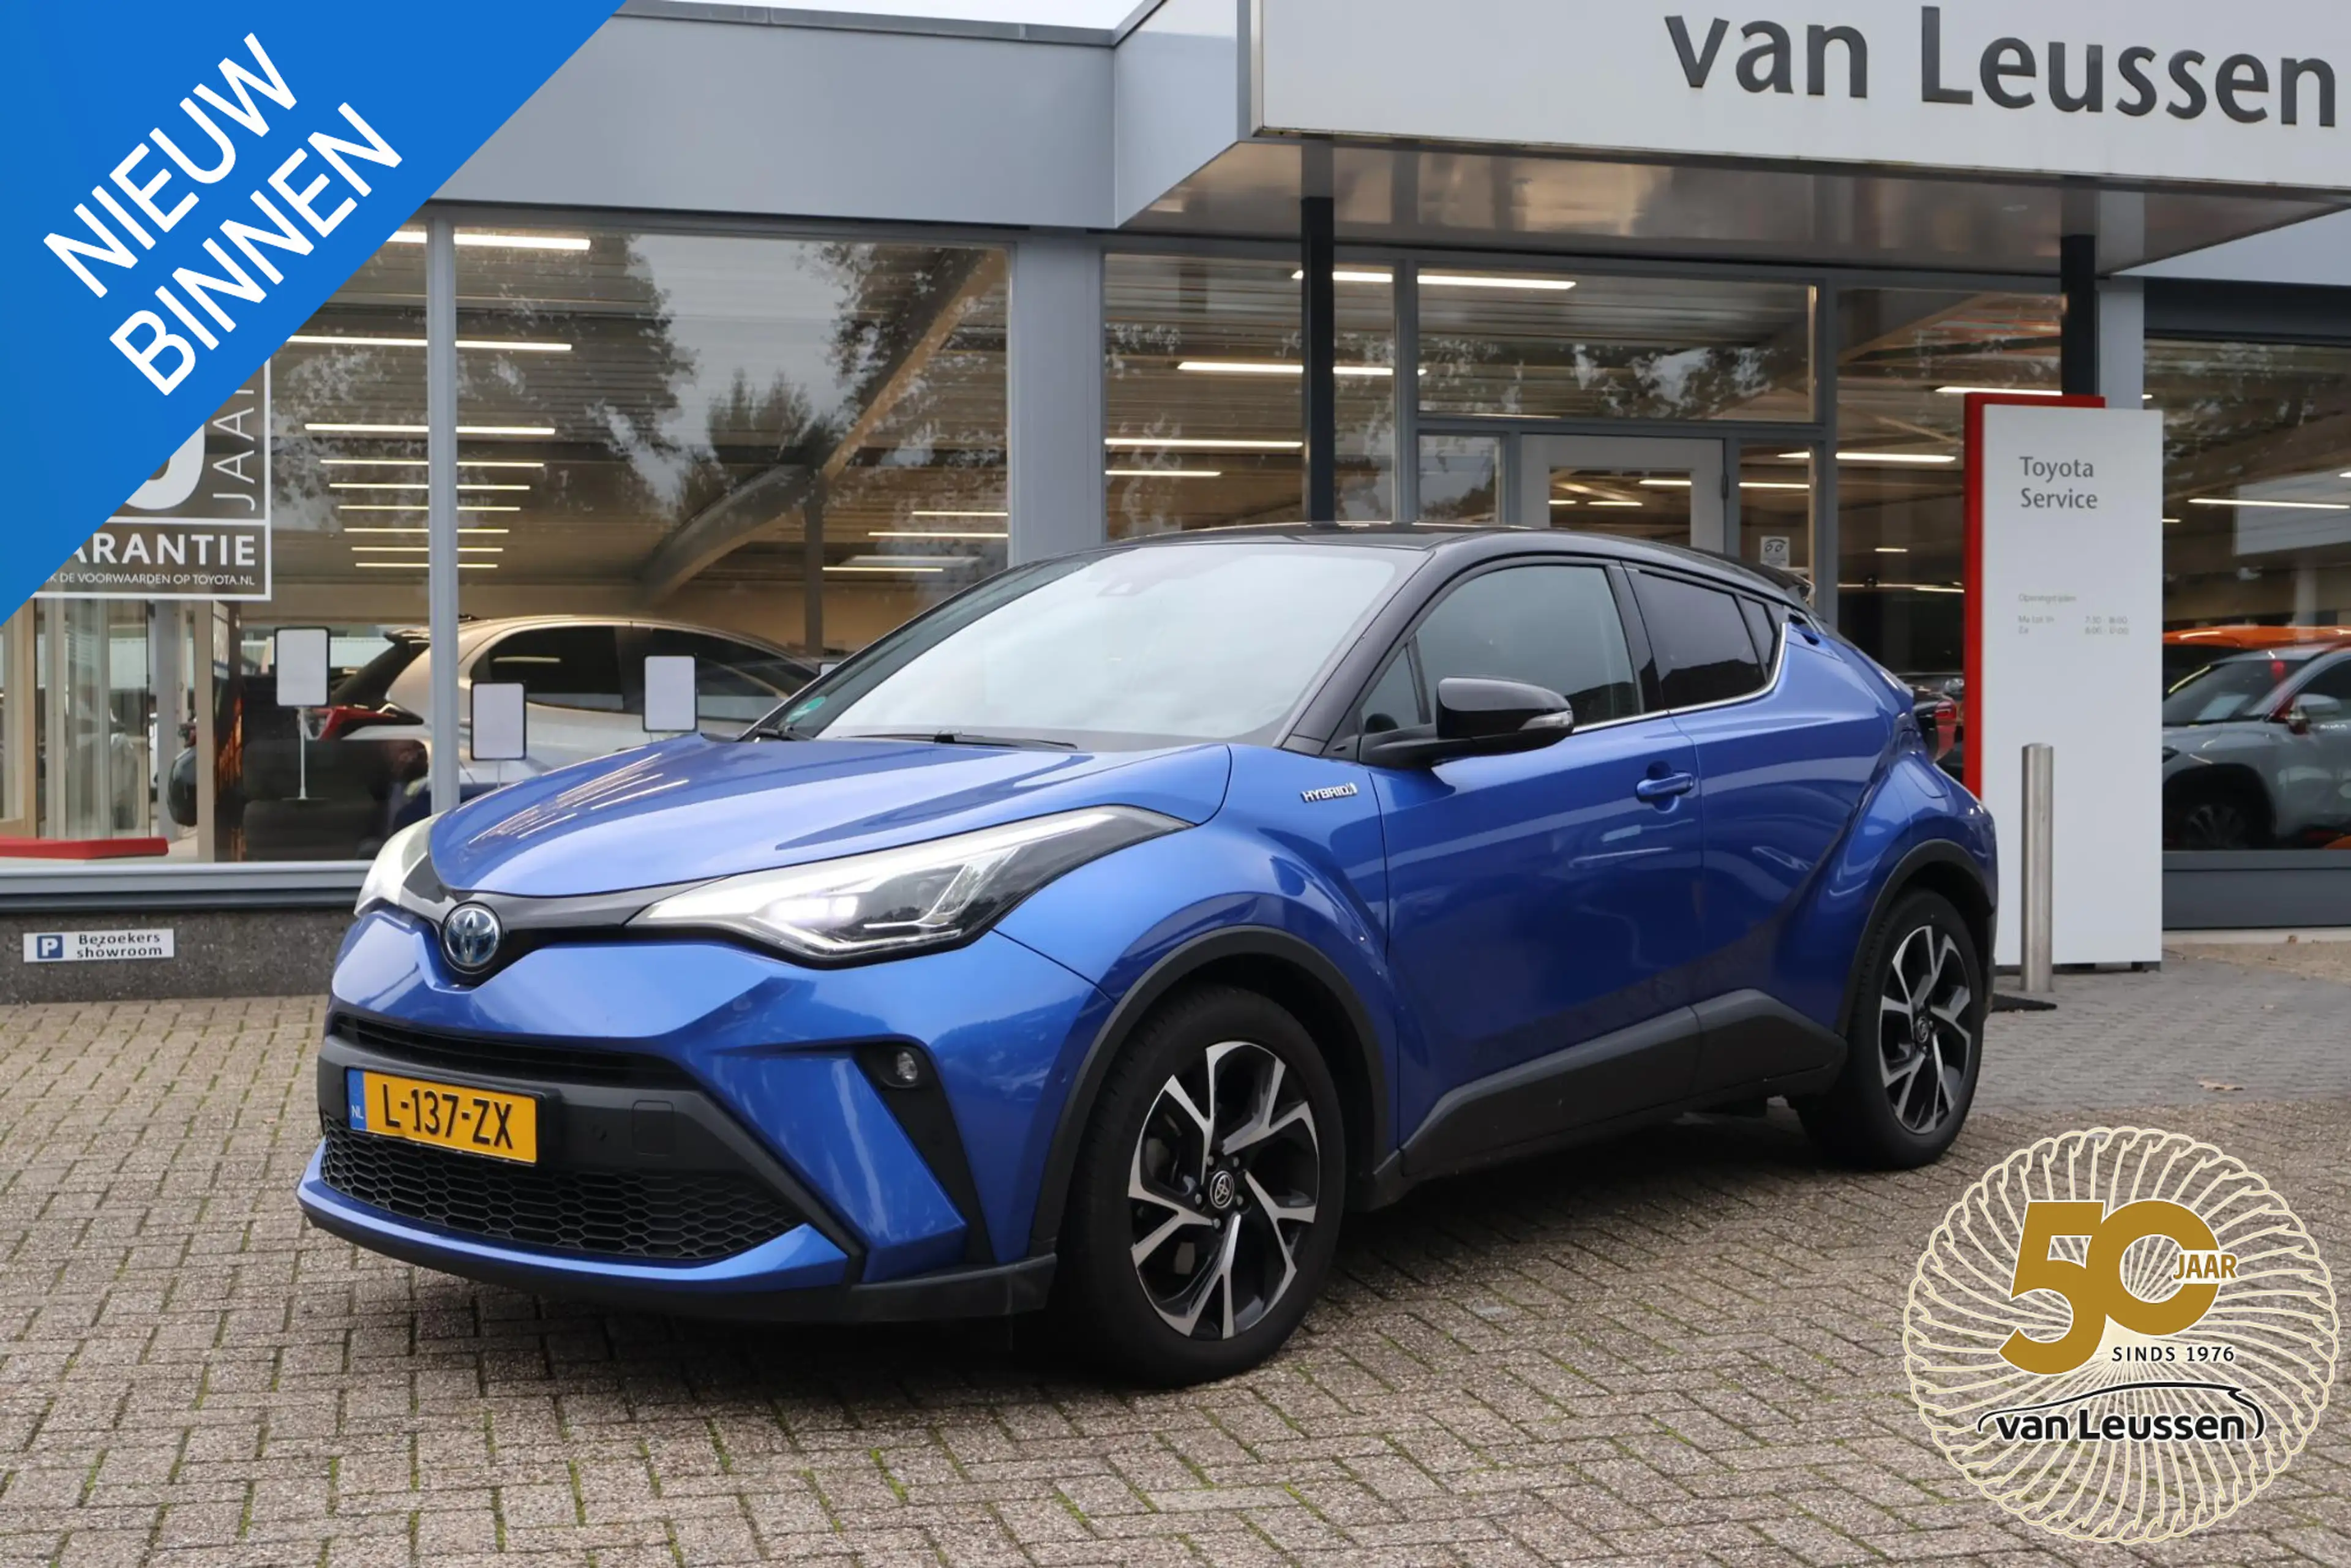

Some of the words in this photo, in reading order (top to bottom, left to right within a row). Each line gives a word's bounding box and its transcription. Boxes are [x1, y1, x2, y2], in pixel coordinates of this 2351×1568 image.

[1664, 15, 1868, 99] van
[1921, 6, 2336, 128] Leussen
[212, 388, 256, 512] JAA
[2019, 456, 2094, 484] Toyota
[2020, 487, 2098, 509] Service
[59, 572, 75, 583] DE
[77, 573, 171, 585] VOORWAARDEN
[173, 574, 190, 585] OP
[193, 574, 255, 586] TOYOTA.NL
[1301, 785, 1350, 803] HYBRID
[78, 932, 160, 945] Bezoekers
[77, 947, 162, 959] showroom
[351, 1104, 364, 1120] NL
[383, 1083, 513, 1150] L-137-ZX
